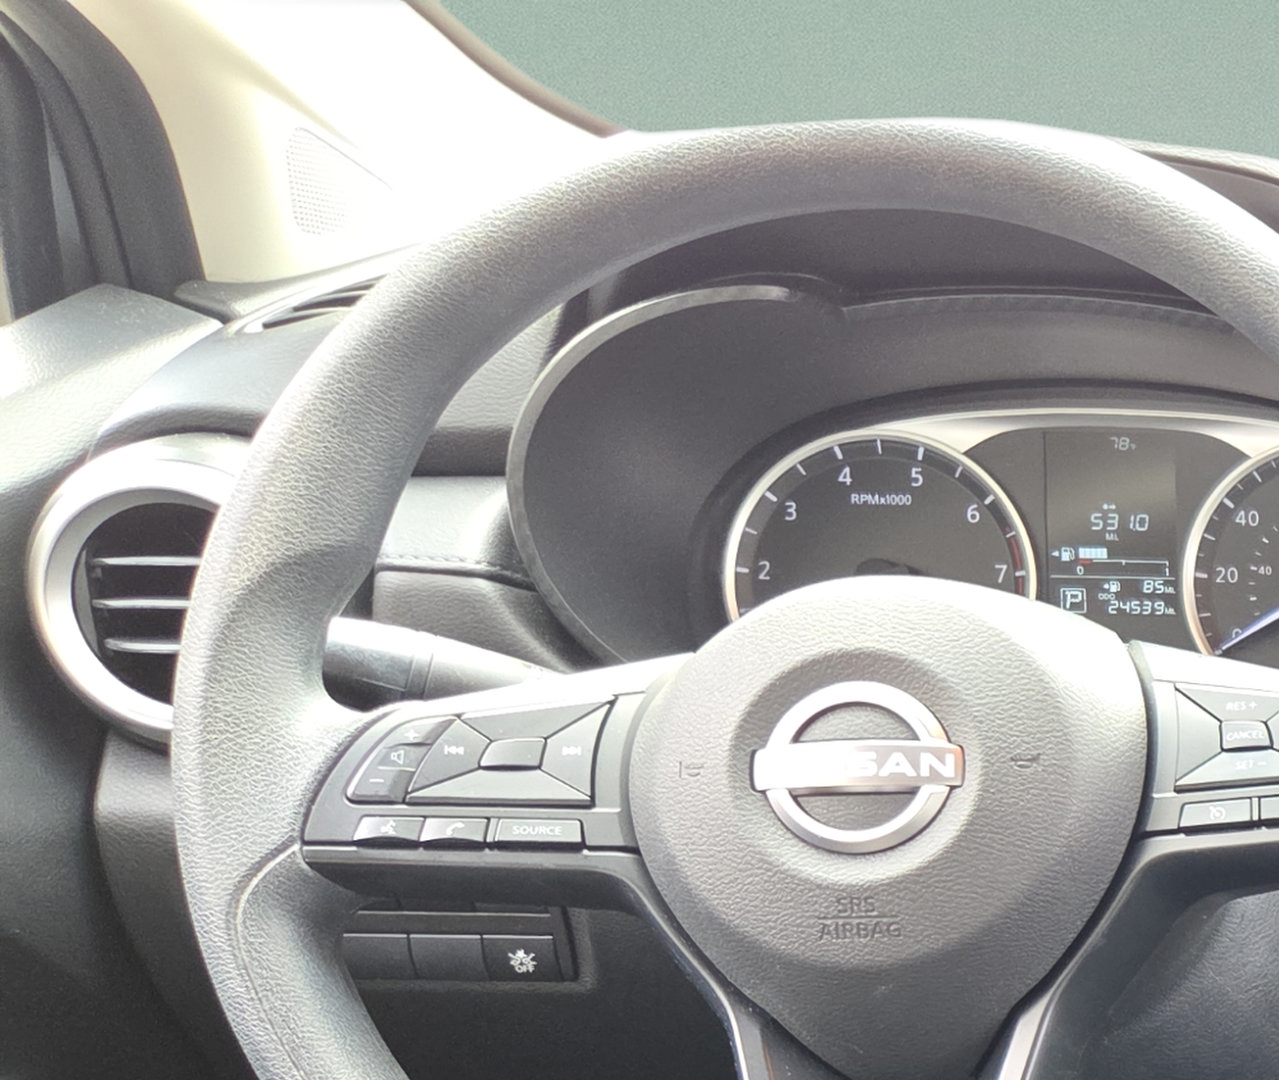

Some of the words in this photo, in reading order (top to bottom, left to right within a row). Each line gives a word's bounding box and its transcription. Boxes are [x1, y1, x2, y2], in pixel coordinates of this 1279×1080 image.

[838, 466, 852, 485] 4
[911, 467, 923, 486] 5
[784, 502, 797, 521] 3
[966, 505, 980, 523] 6
[1235, 510, 1259, 526] 40
[758, 562, 770, 580] 2
[994, 565, 1007, 583] 7
[1215, 567, 1238, 583] 20
[1258, 566, 1272, 576] 40
[1065, 591, 1082, 609] P
[1108, 601, 1165, 615] 24539
[1226, 701, 1247, 711] RES
[1226, 730, 1265, 741] CANCEL
[1234, 759, 1254, 770] SET
[512, 824, 563, 836] SOURCE
[837, 897, 876, 914] SRS
[818, 920, 902, 940] AIRBAG
